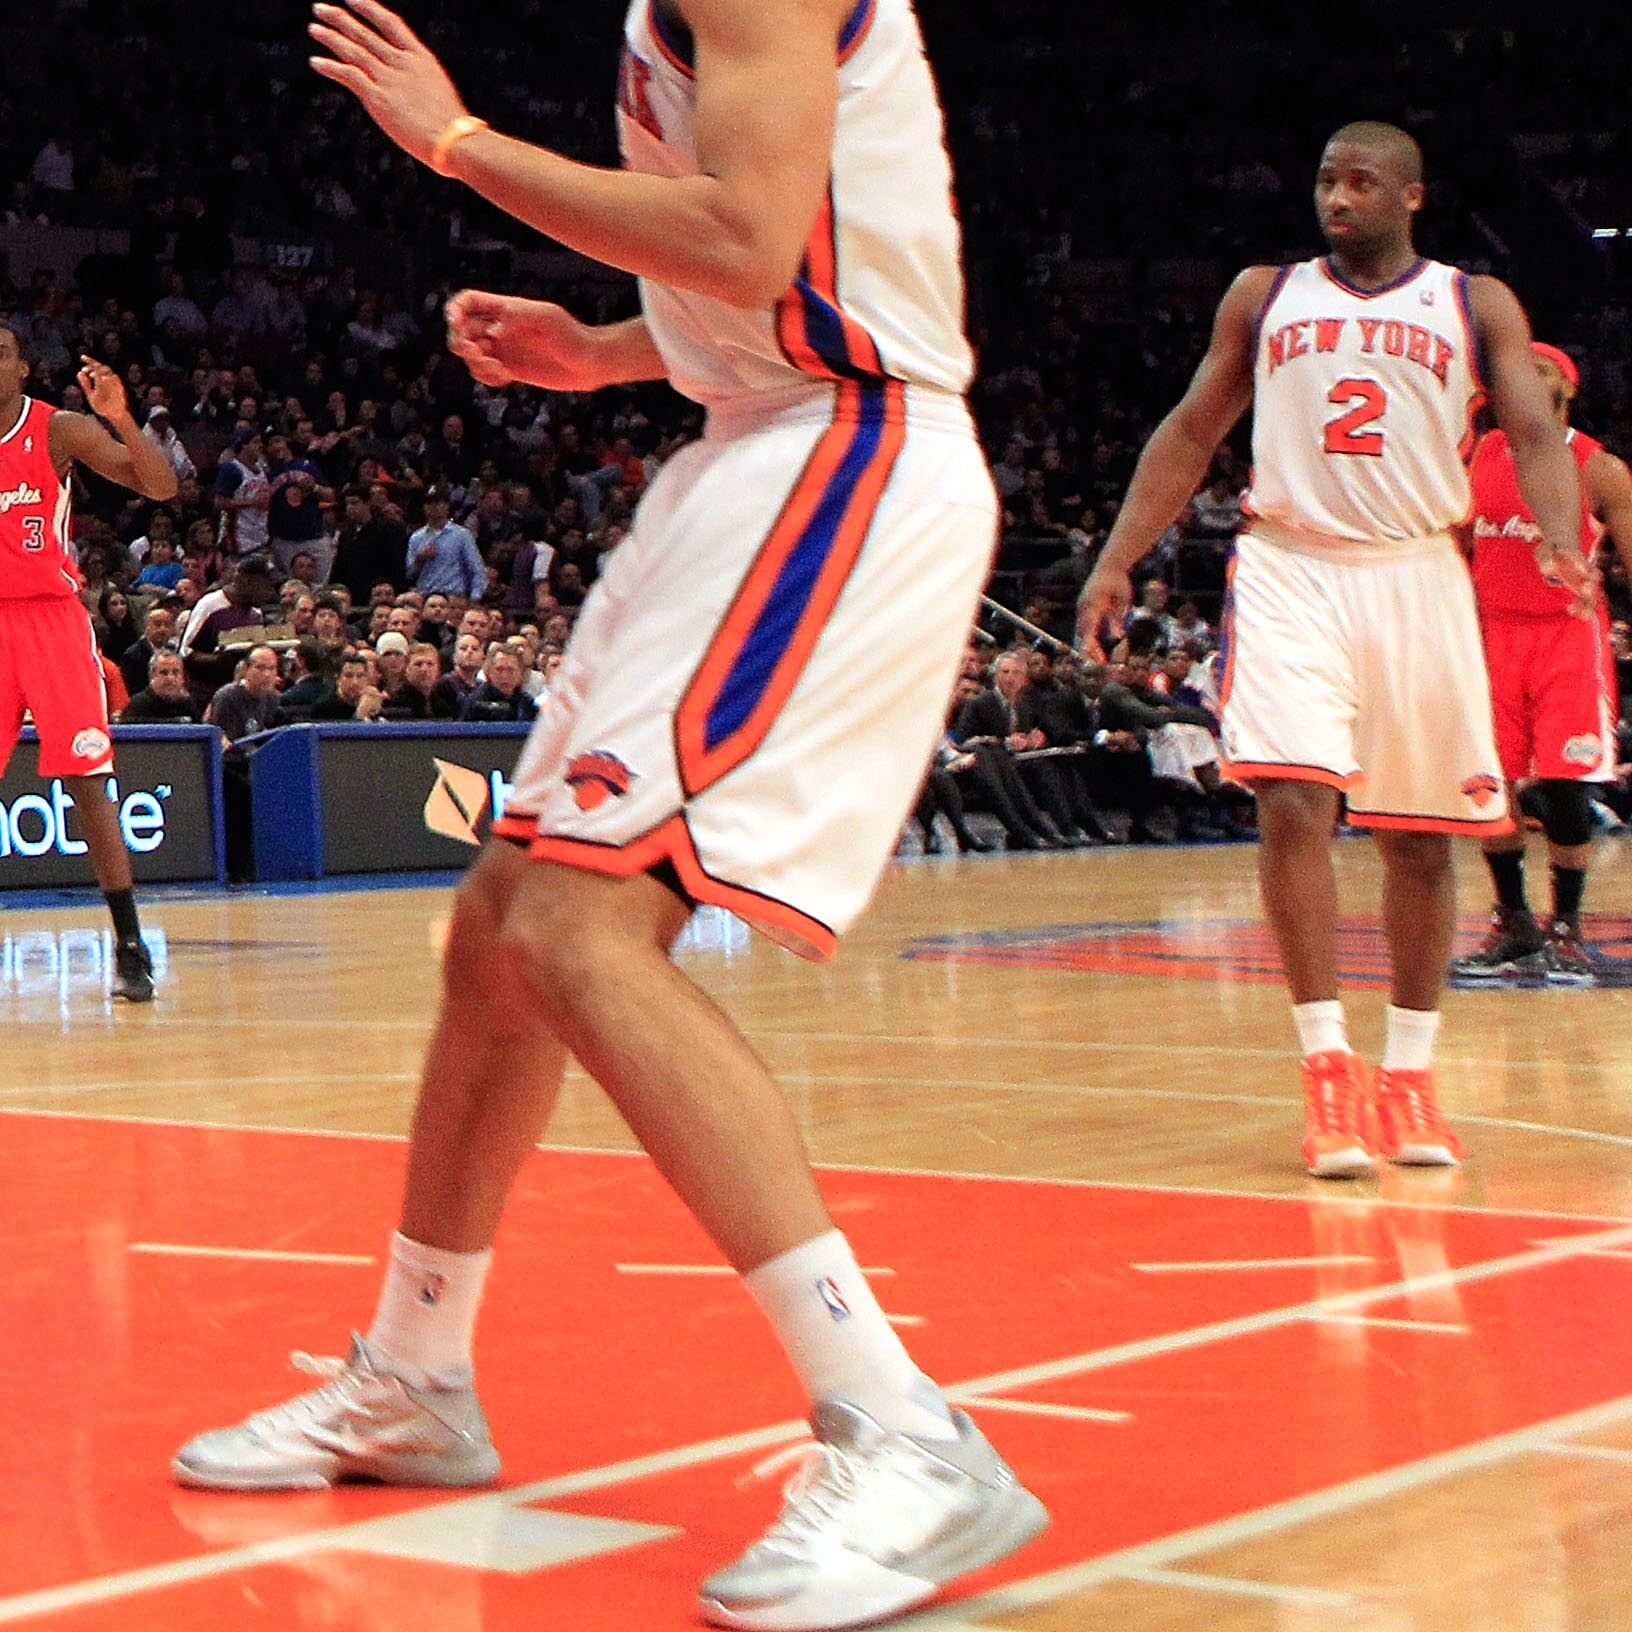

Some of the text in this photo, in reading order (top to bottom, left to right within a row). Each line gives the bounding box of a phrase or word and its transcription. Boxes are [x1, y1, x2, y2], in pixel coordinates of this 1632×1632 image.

[1267, 316, 1455, 390] NEW YORK
[1323, 378, 1388, 457] 2
[22, 515, 46, 552] 3
